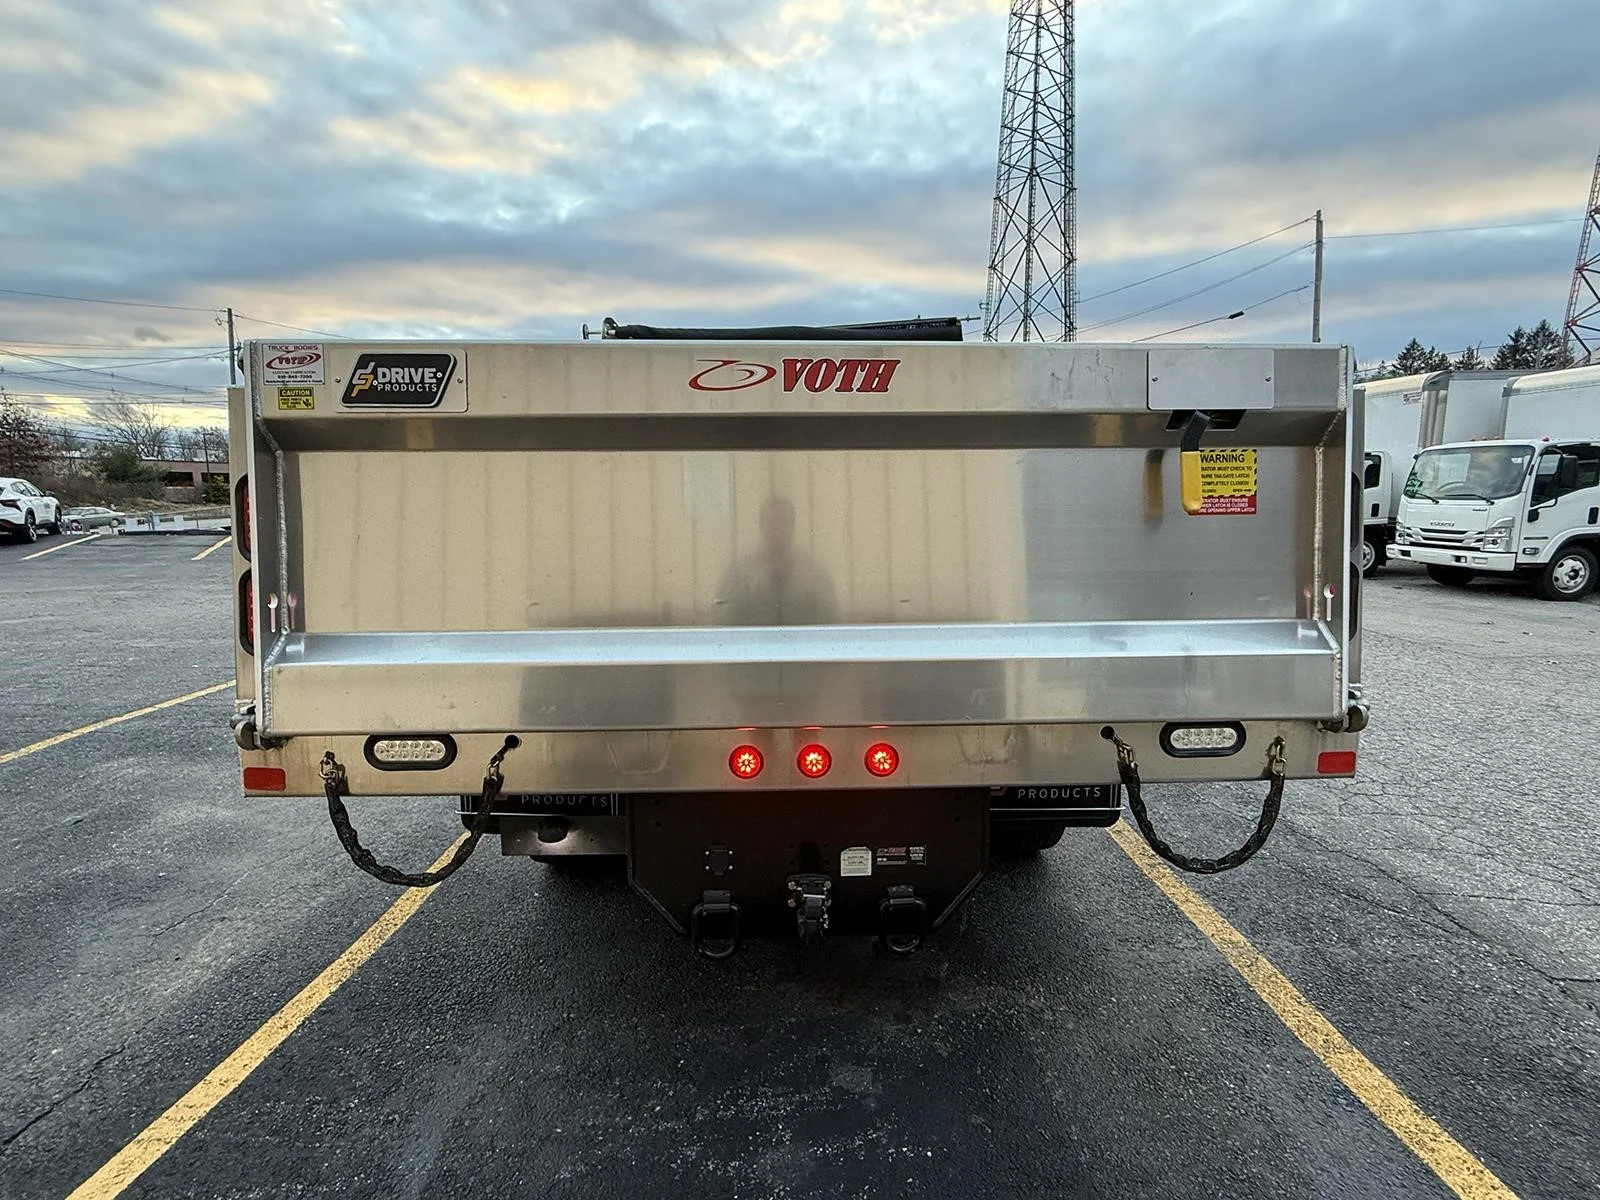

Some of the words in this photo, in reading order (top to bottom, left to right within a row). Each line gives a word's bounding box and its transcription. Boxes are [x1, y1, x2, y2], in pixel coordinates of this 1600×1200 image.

[377, 367, 437, 383] DRIVE
[782, 358, 901, 393] VOTH
[281, 389, 311, 397] CAUTION
[377, 383, 438, 392] PRODUCTS
[1200, 453, 1245, 463] WARNING
[1017, 786, 1102, 799] PRODUCTS
